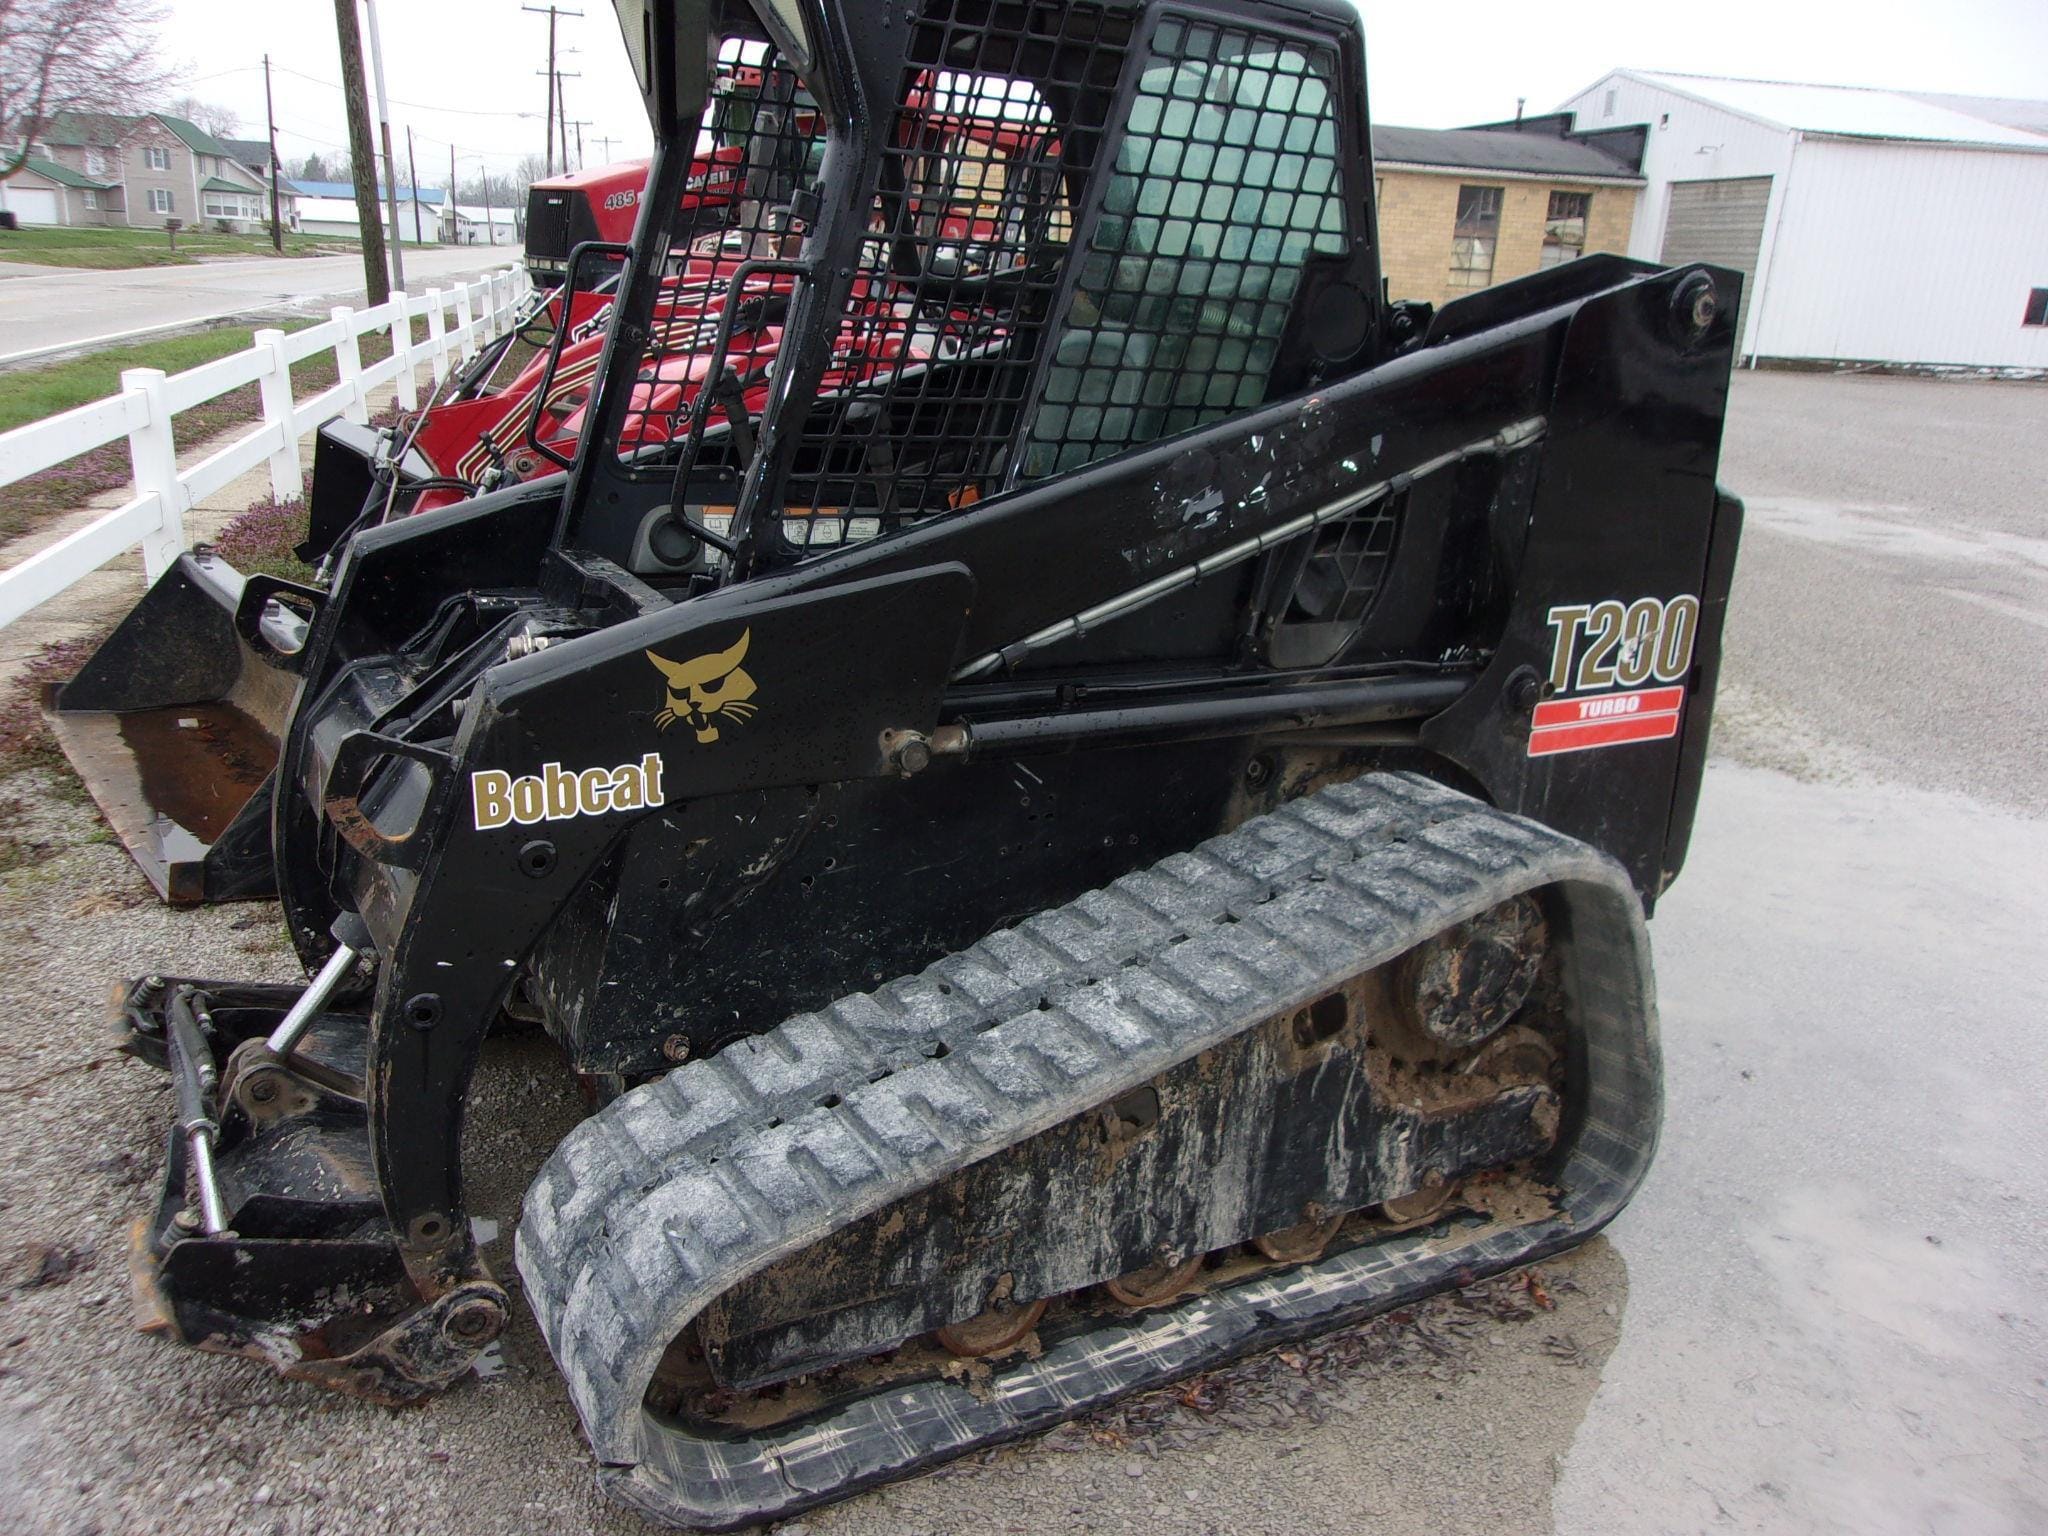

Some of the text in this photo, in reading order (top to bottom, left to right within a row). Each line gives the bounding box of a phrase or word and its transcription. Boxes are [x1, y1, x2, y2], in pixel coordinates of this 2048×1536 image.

[604, 189, 635, 211] 485
[1547, 594, 1700, 693] T200
[1579, 696, 1640, 719] TURBO
[471, 752, 664, 831] Bobcat
